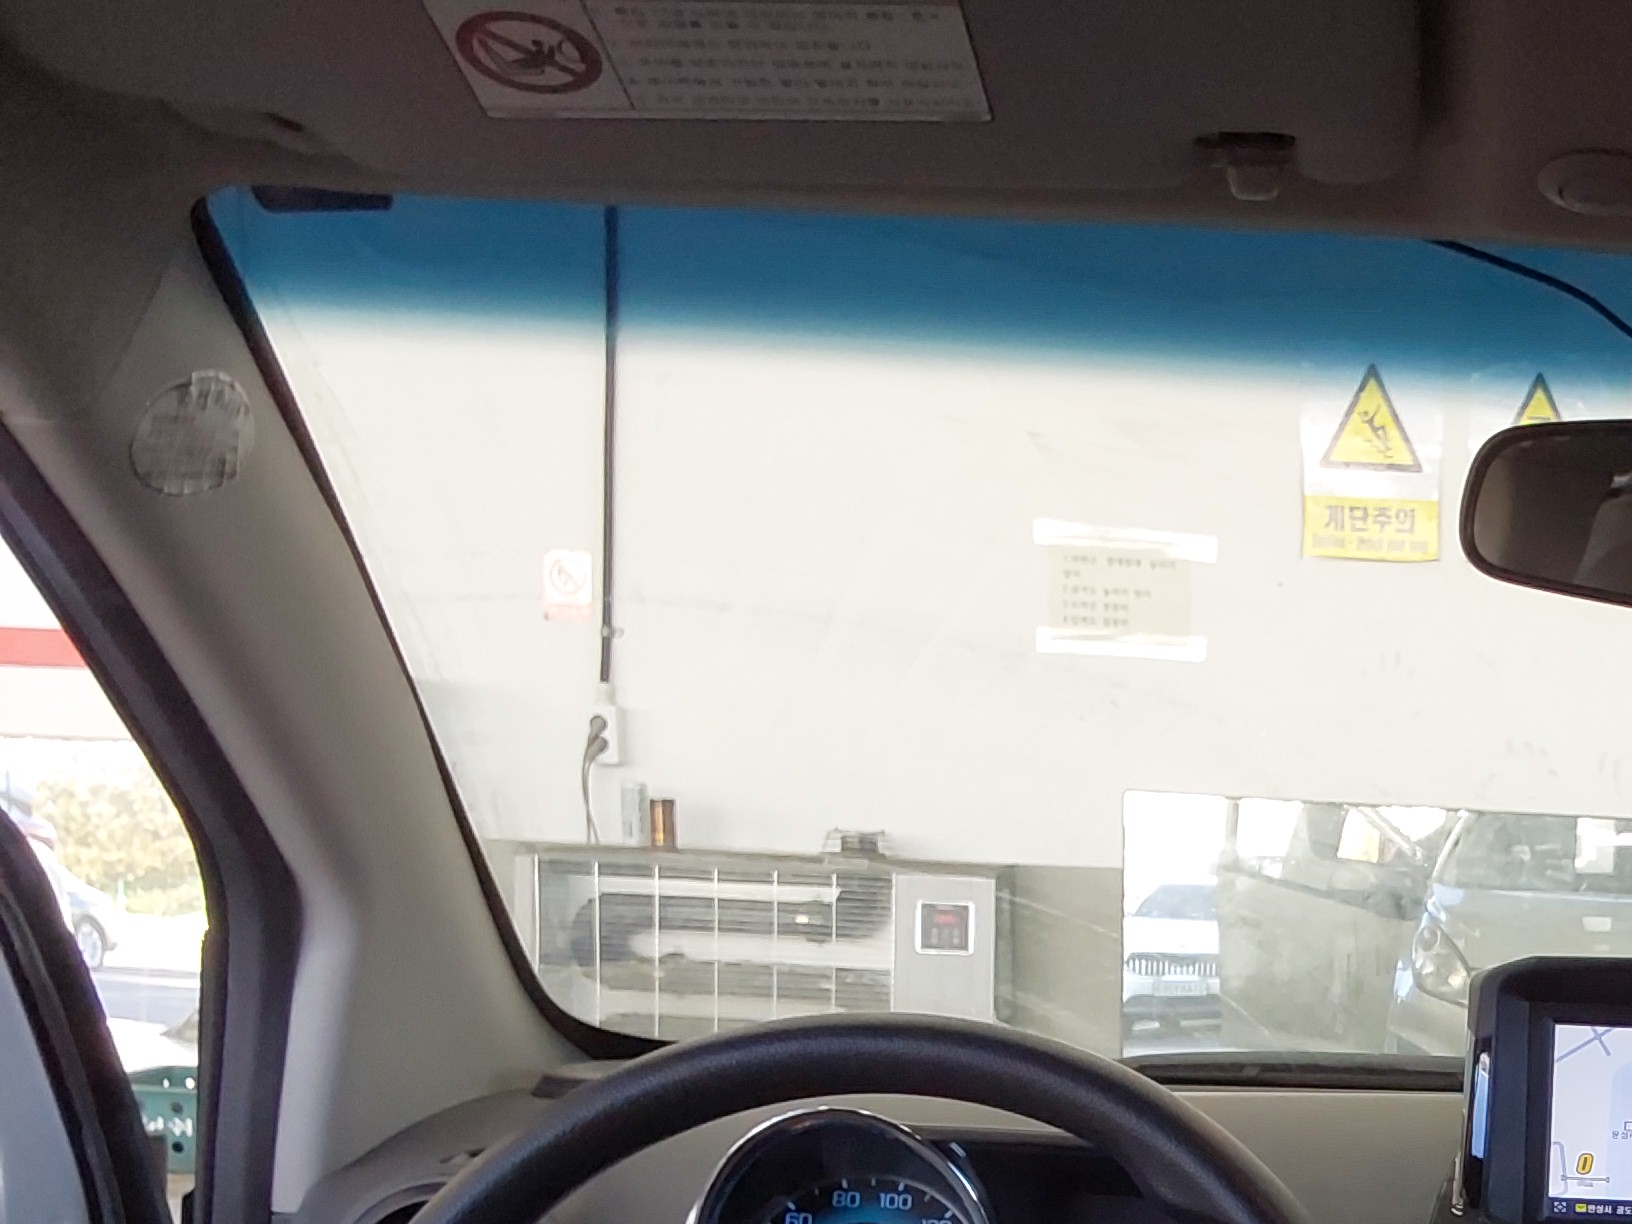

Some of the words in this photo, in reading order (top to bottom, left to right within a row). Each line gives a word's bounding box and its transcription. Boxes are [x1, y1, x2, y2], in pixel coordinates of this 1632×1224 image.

[1324, 504, 1416, 535] 계단주의
[832, 1191, 861, 1209] 80
[879, 1192, 913, 1210] 100
